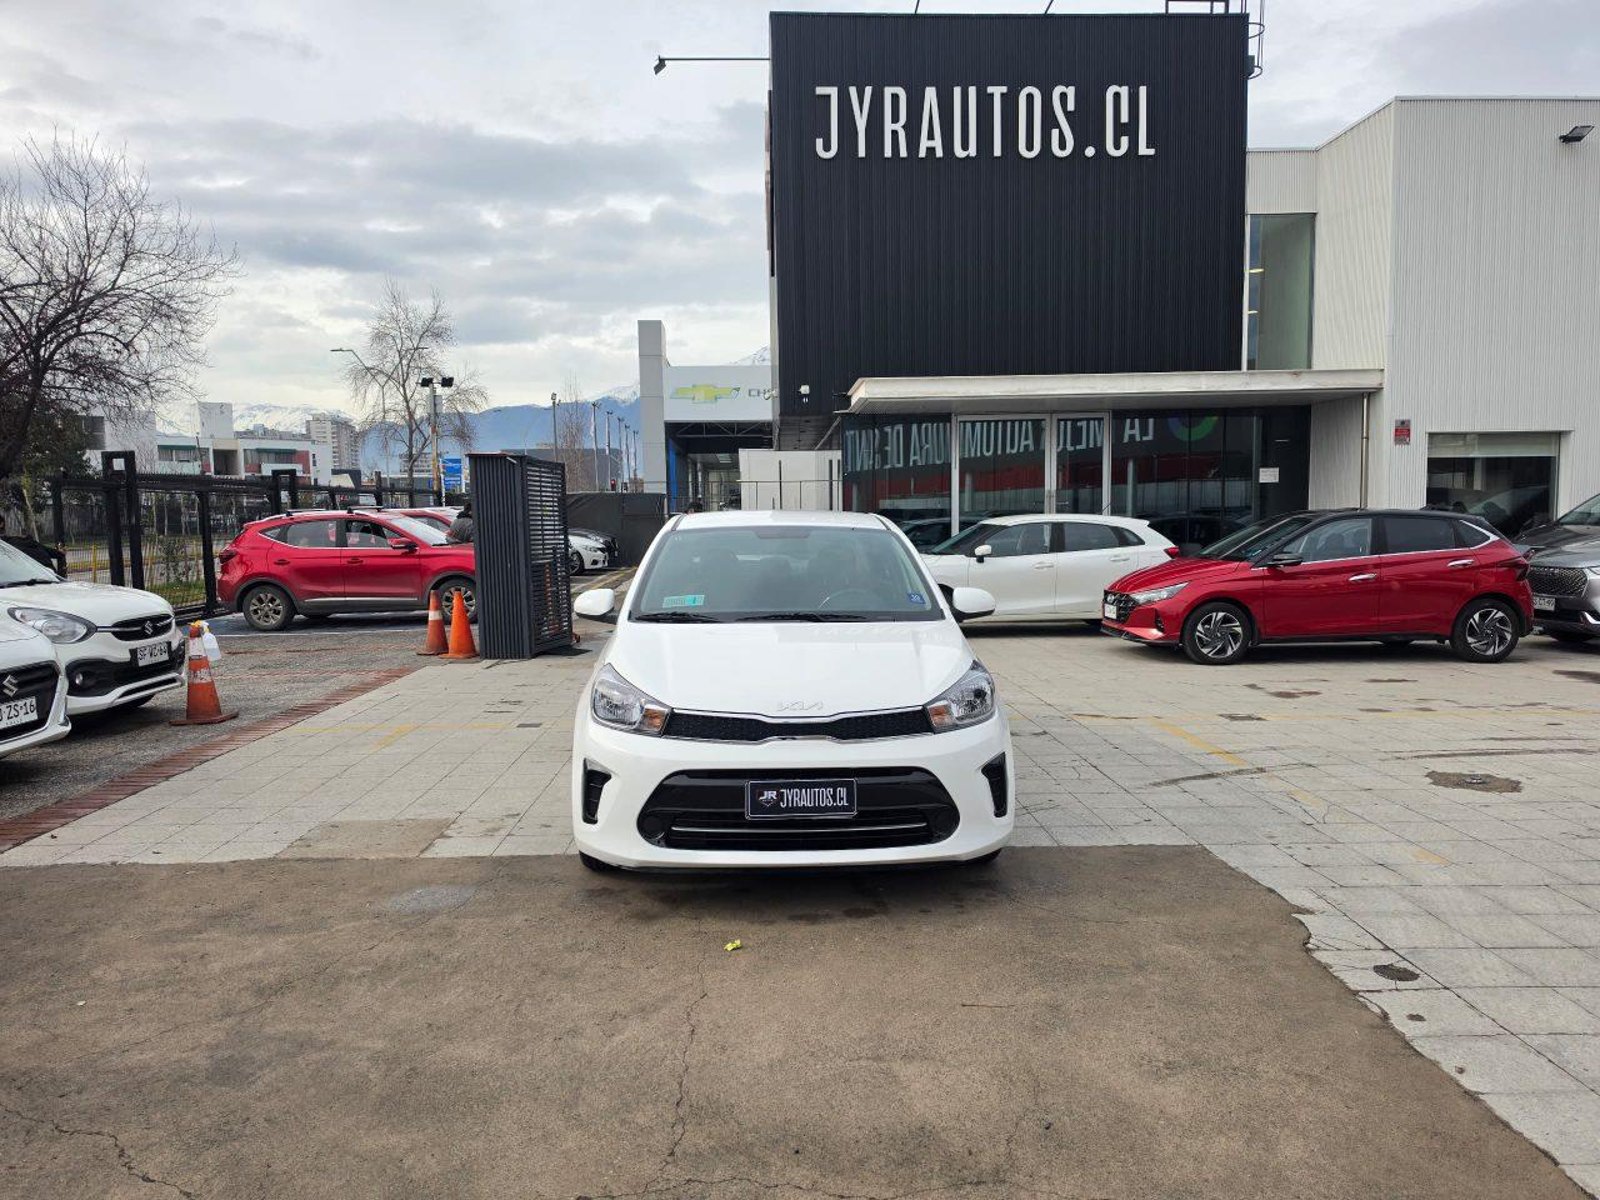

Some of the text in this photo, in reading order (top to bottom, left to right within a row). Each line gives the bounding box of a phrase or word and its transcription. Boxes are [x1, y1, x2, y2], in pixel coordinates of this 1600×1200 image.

[815, 85, 1155, 159] JYRAUTOS.CL
[759, 787, 849, 808] JR JYRAUTOS.CL
